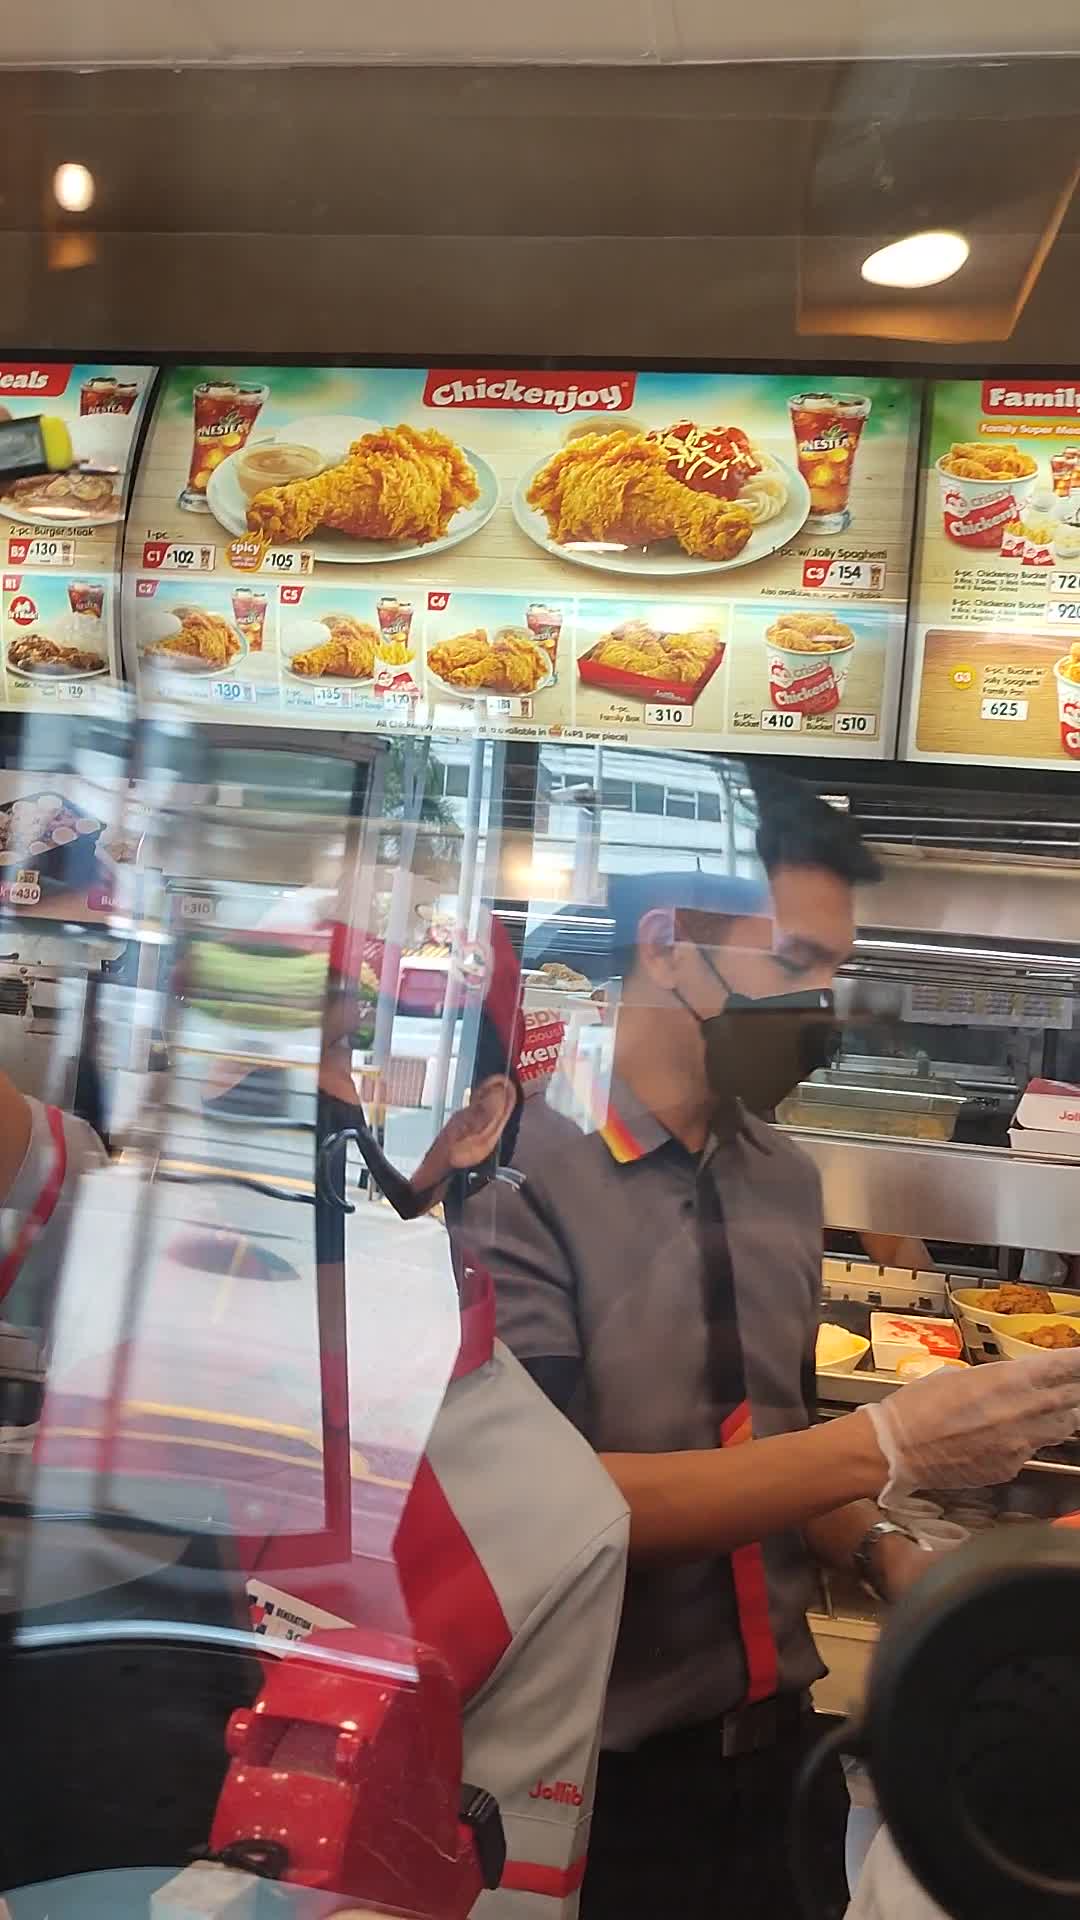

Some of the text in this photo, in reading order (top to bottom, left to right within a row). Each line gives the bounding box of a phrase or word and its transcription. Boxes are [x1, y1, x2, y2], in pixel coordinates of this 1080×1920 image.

[0, 371, 49, 389] eals
[432, 377, 623, 413] Chickenjoy
[34, 527, 65, 537] Burger
[66, 527, 95, 537] Steak
[231, 542, 261, 556] spicy
[146, 550, 161, 562] C1
[806, 567, 825, 579] C3
[1058, 574, 1080, 589] 72
[138, 583, 154, 594] C2
[282, 589, 299, 601] C5
[430, 595, 447, 608] C6
